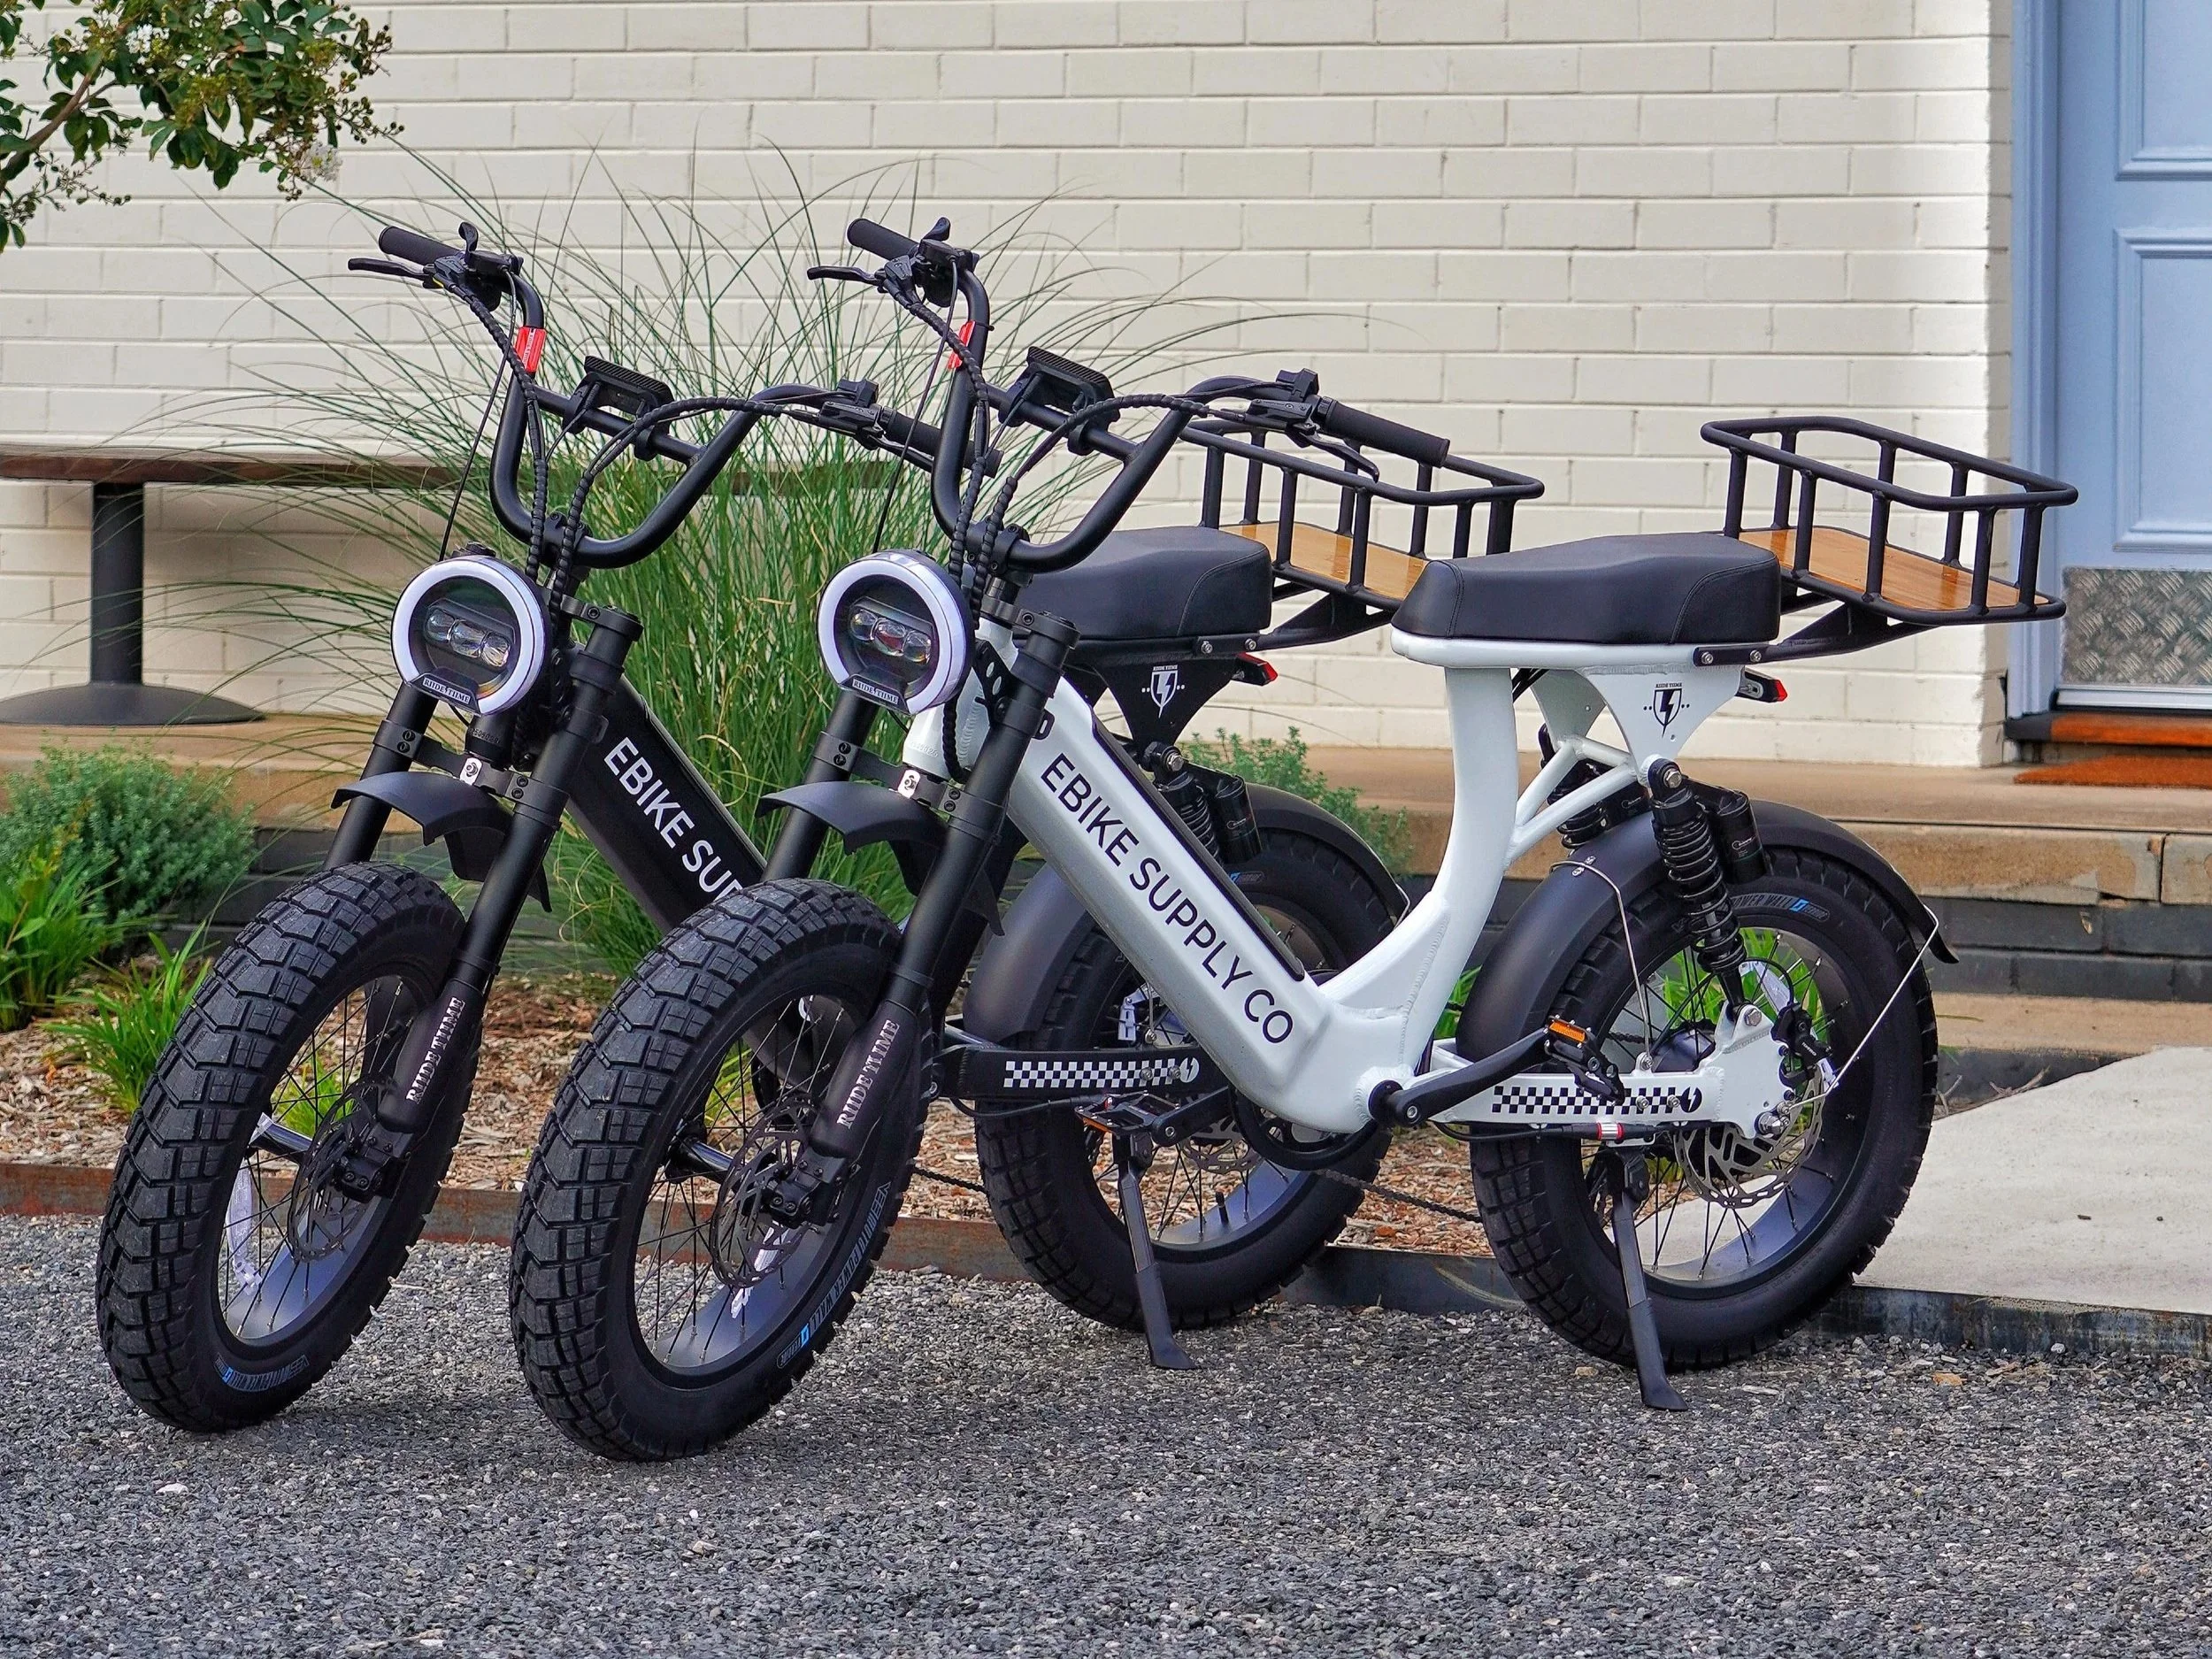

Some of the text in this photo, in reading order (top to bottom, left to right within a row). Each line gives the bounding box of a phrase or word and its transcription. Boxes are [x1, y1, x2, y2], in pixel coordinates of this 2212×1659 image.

[603, 736, 695, 849] EBIKE
[1041, 753, 1294, 1044] EBIKE SUPPLY CO
[836, 1073, 873, 1130] RIIDE
